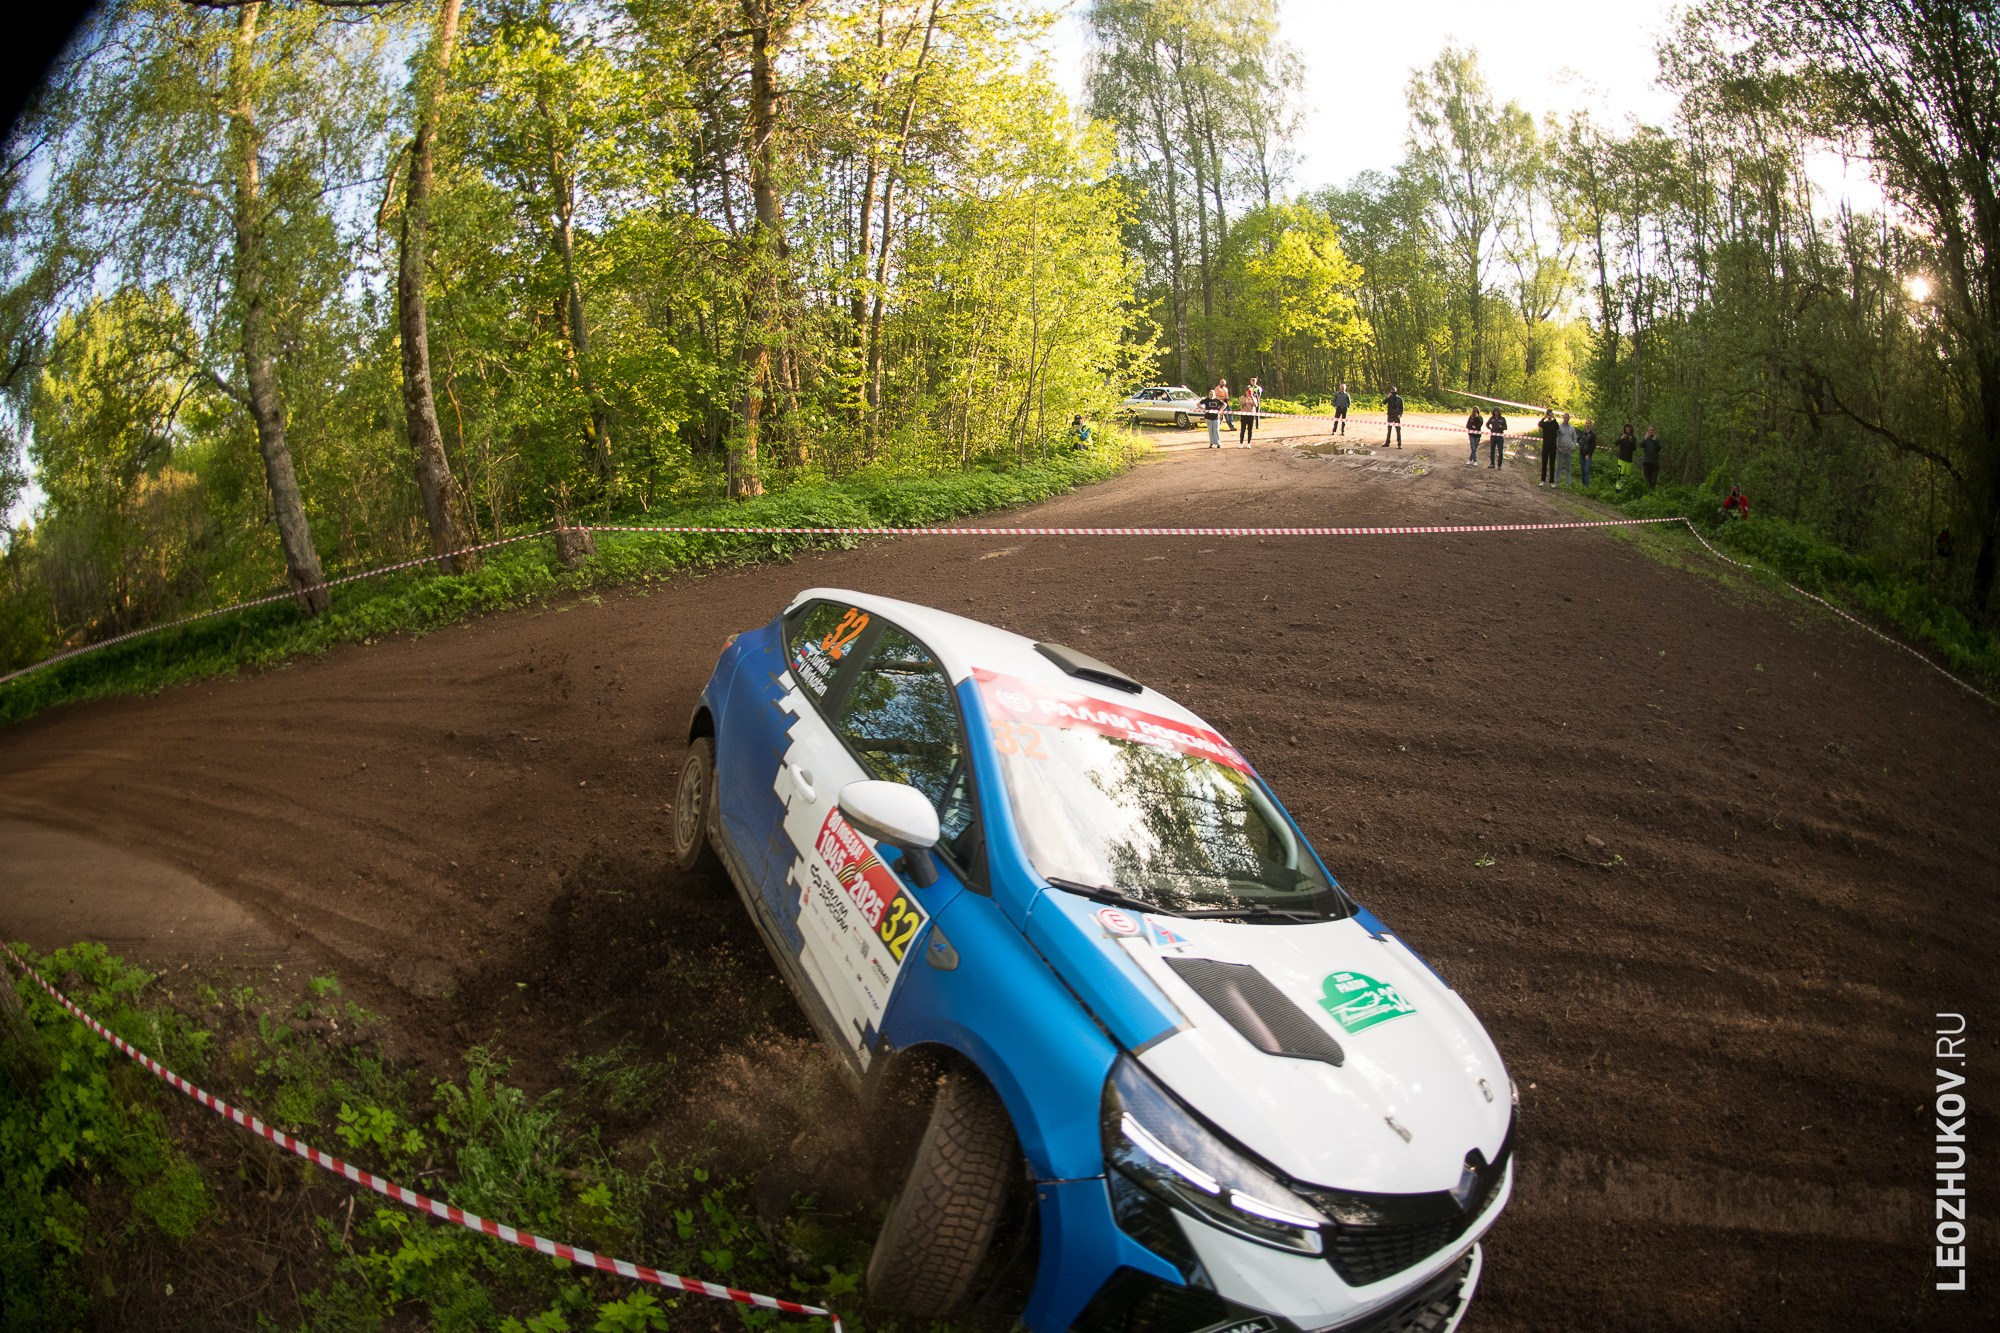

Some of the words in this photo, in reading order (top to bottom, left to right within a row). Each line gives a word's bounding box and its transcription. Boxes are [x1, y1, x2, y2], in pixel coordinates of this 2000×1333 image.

[821, 608, 870, 660] 32
[990, 719, 1050, 761] 32
[827, 810, 844, 833] 80
[819, 829, 848, 876] 1945
[849, 872, 885, 928] 2025
[880, 897, 920, 961] 32
